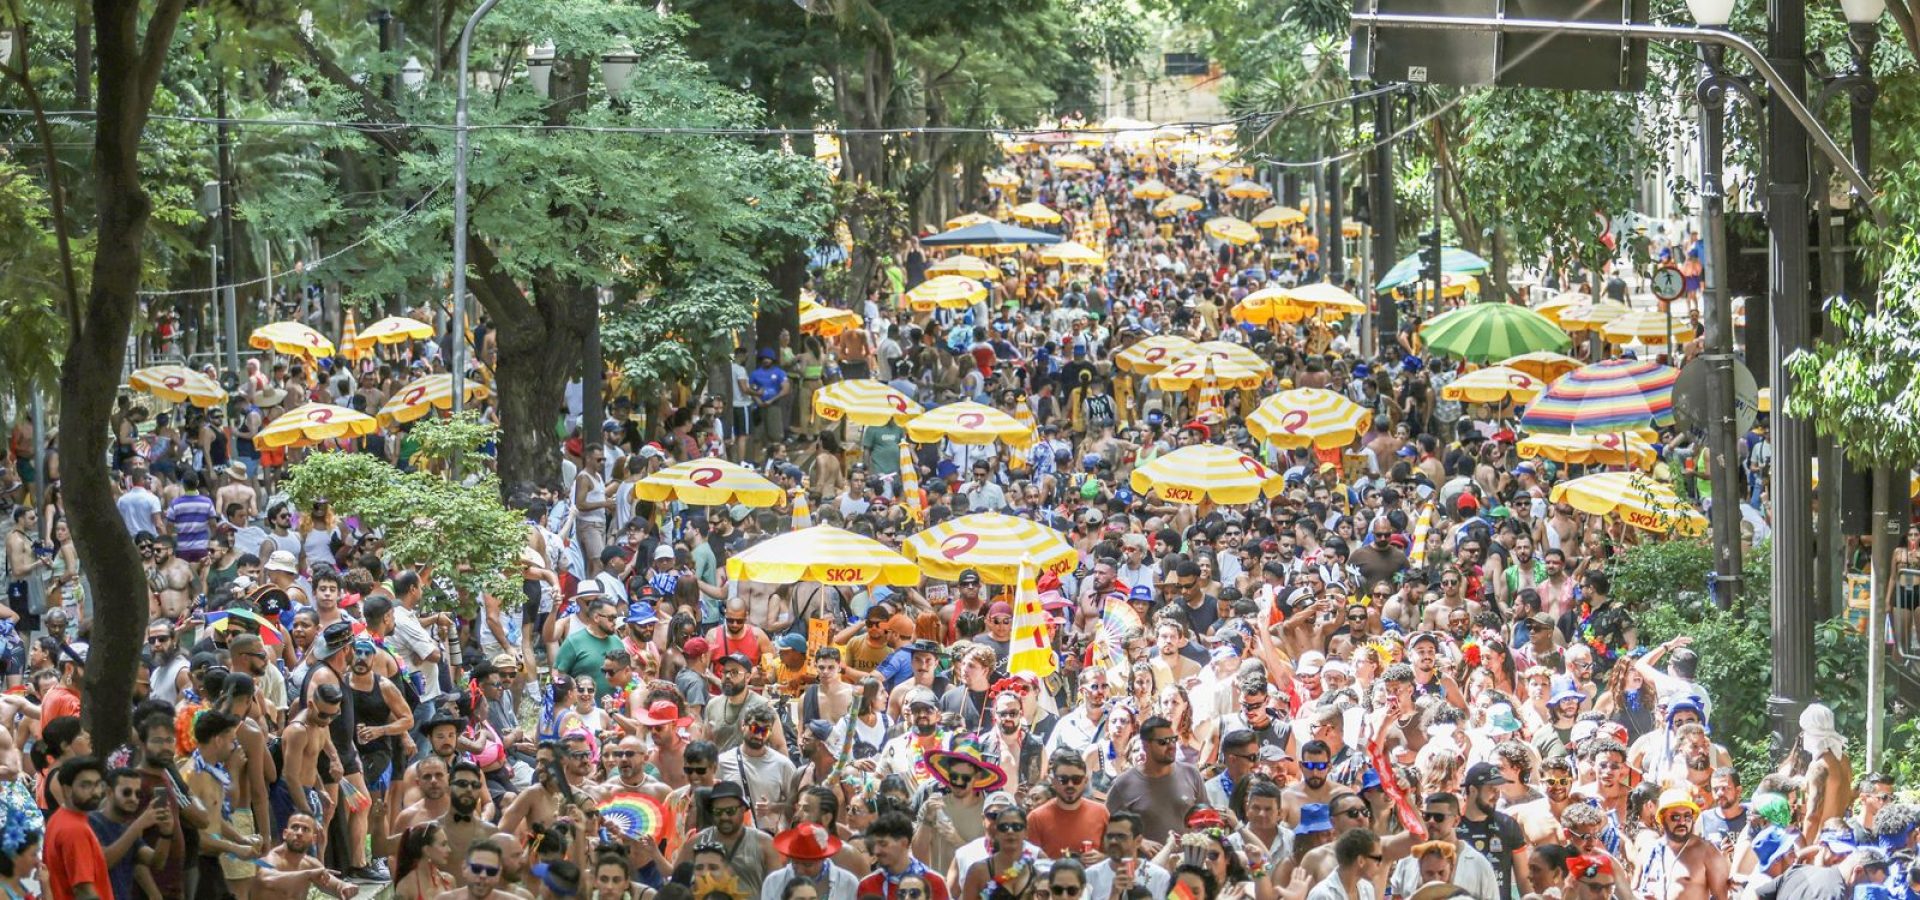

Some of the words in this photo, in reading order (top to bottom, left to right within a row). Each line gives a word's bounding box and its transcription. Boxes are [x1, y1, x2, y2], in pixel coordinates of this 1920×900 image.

[1165, 487, 1194, 500] SKOL
[1628, 512, 1658, 528] SKOL
[1050, 558, 1071, 576] SKOL
[827, 568, 864, 581] SKOL
